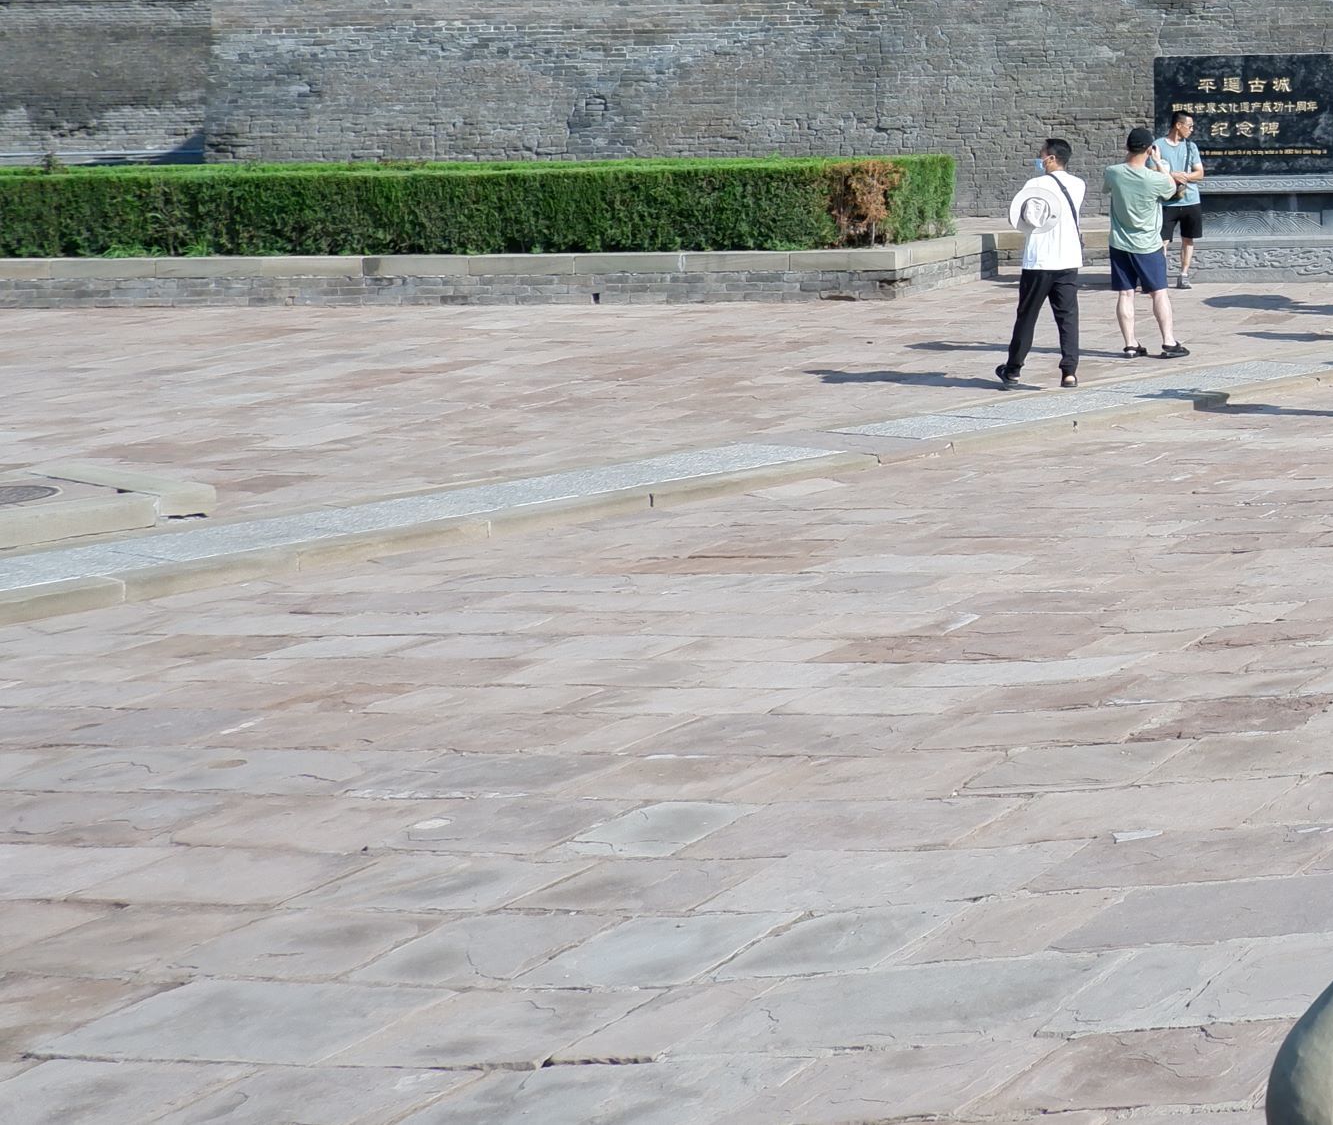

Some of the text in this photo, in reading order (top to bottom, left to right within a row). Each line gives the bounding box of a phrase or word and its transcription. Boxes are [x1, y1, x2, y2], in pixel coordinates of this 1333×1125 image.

[1197, 76, 1293, 94] 平遥古城
[1210, 121, 1280, 138] 纪念碑
